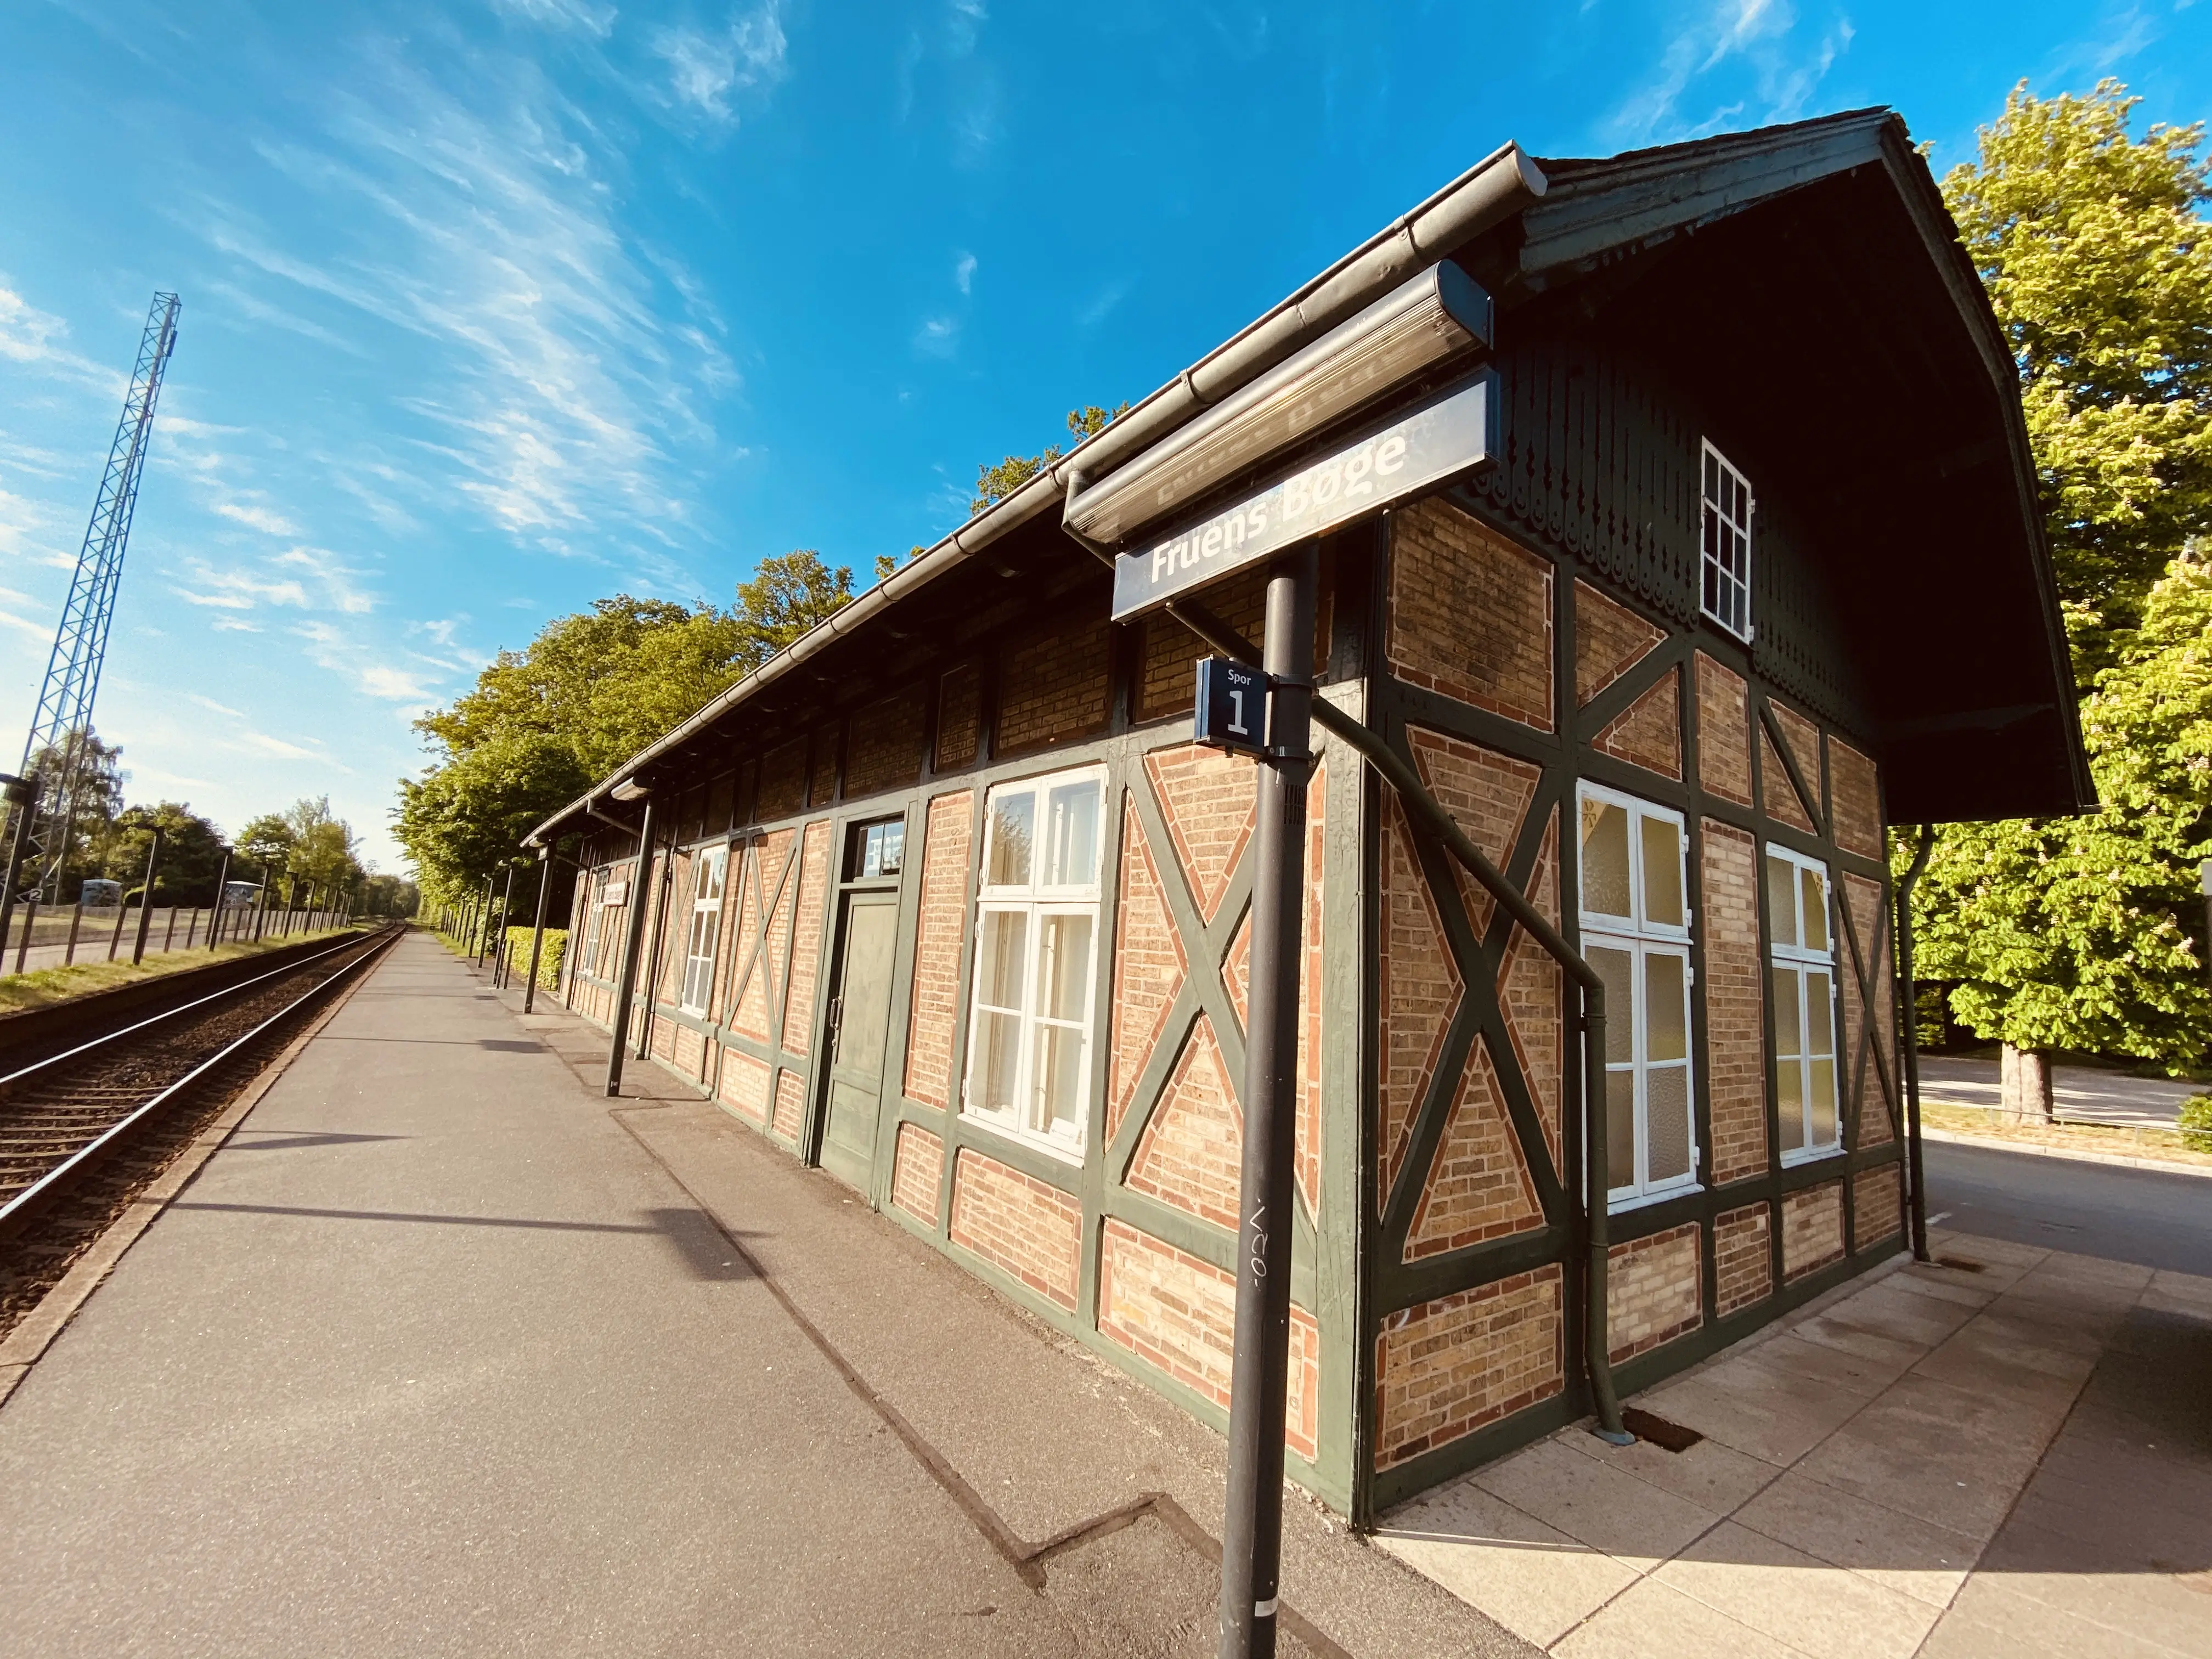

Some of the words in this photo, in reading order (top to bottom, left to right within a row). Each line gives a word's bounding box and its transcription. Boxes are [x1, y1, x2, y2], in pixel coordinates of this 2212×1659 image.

[1152, 501, 1268, 583] Fruens
[1282, 436, 1406, 522] Bøge
[1227, 669, 1251, 686] Spor
[1228, 690, 1248, 735] 1
[31, 890, 41, 900] 2
